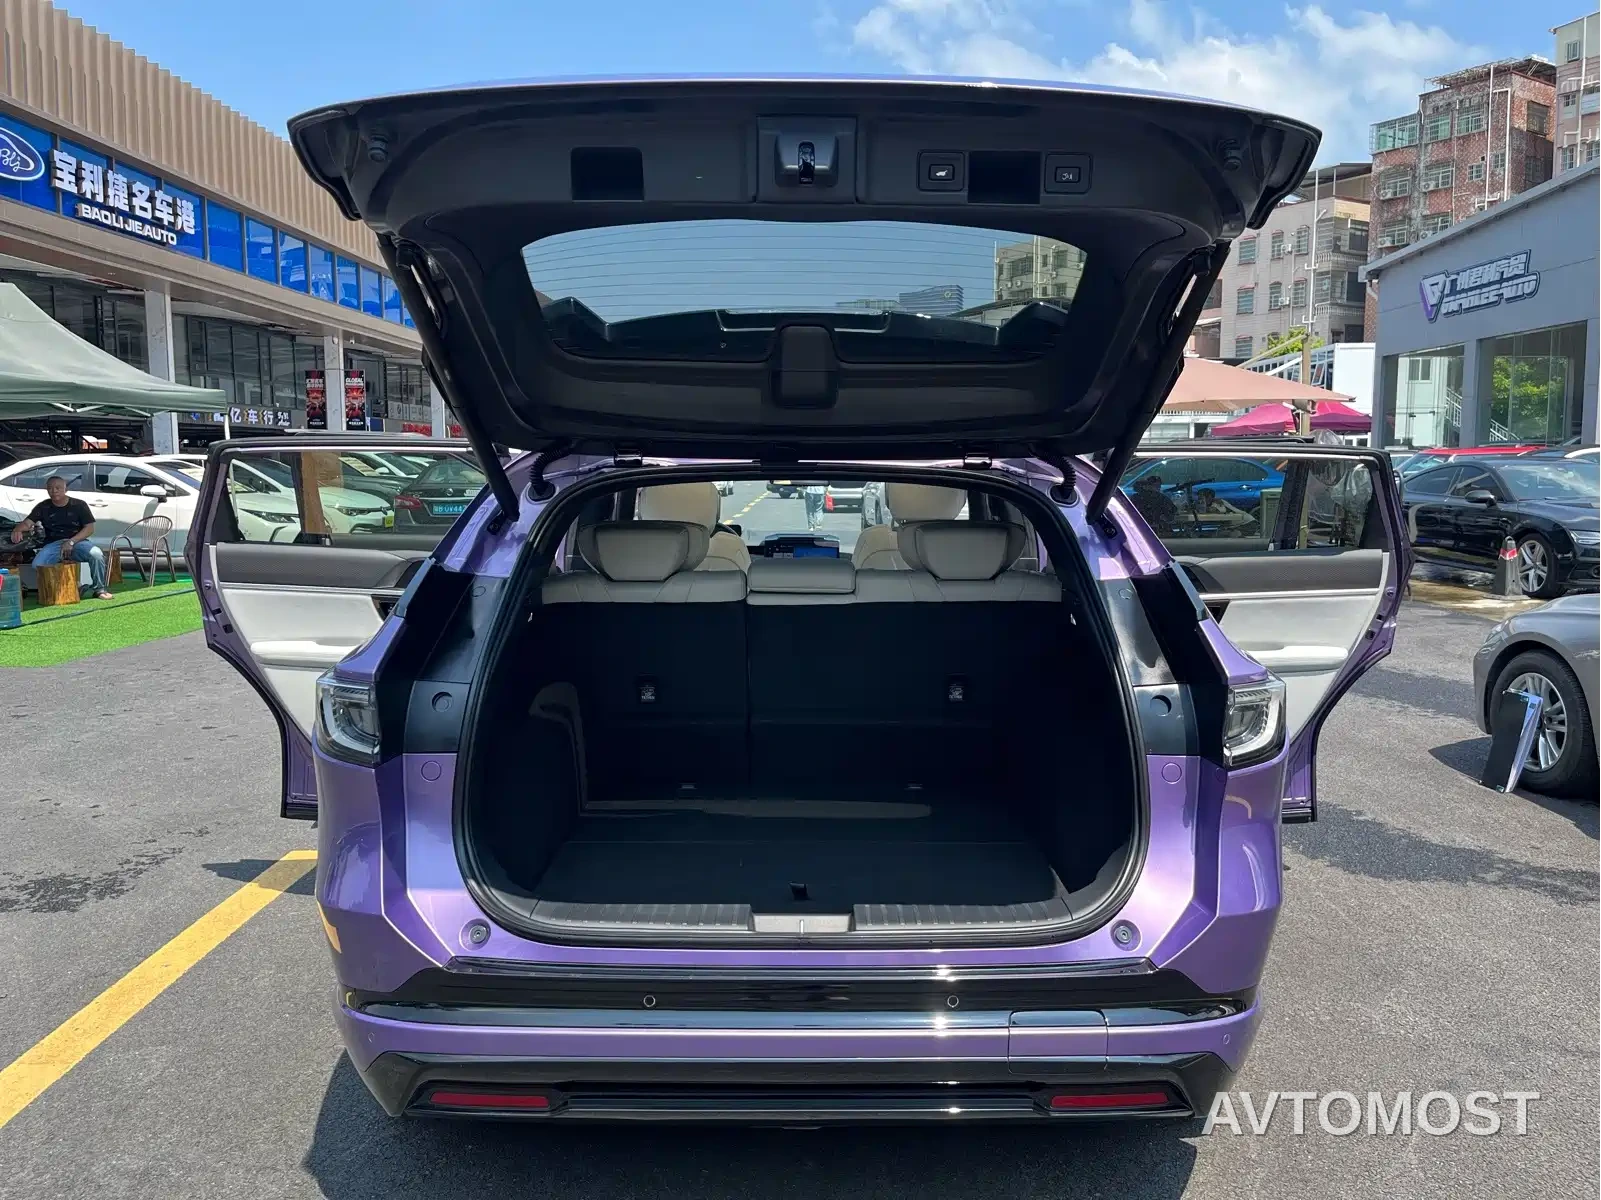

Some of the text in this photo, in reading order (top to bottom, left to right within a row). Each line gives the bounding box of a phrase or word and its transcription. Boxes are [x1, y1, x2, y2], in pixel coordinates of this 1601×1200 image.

[53, 149, 196, 235] 宝利捷名车港
